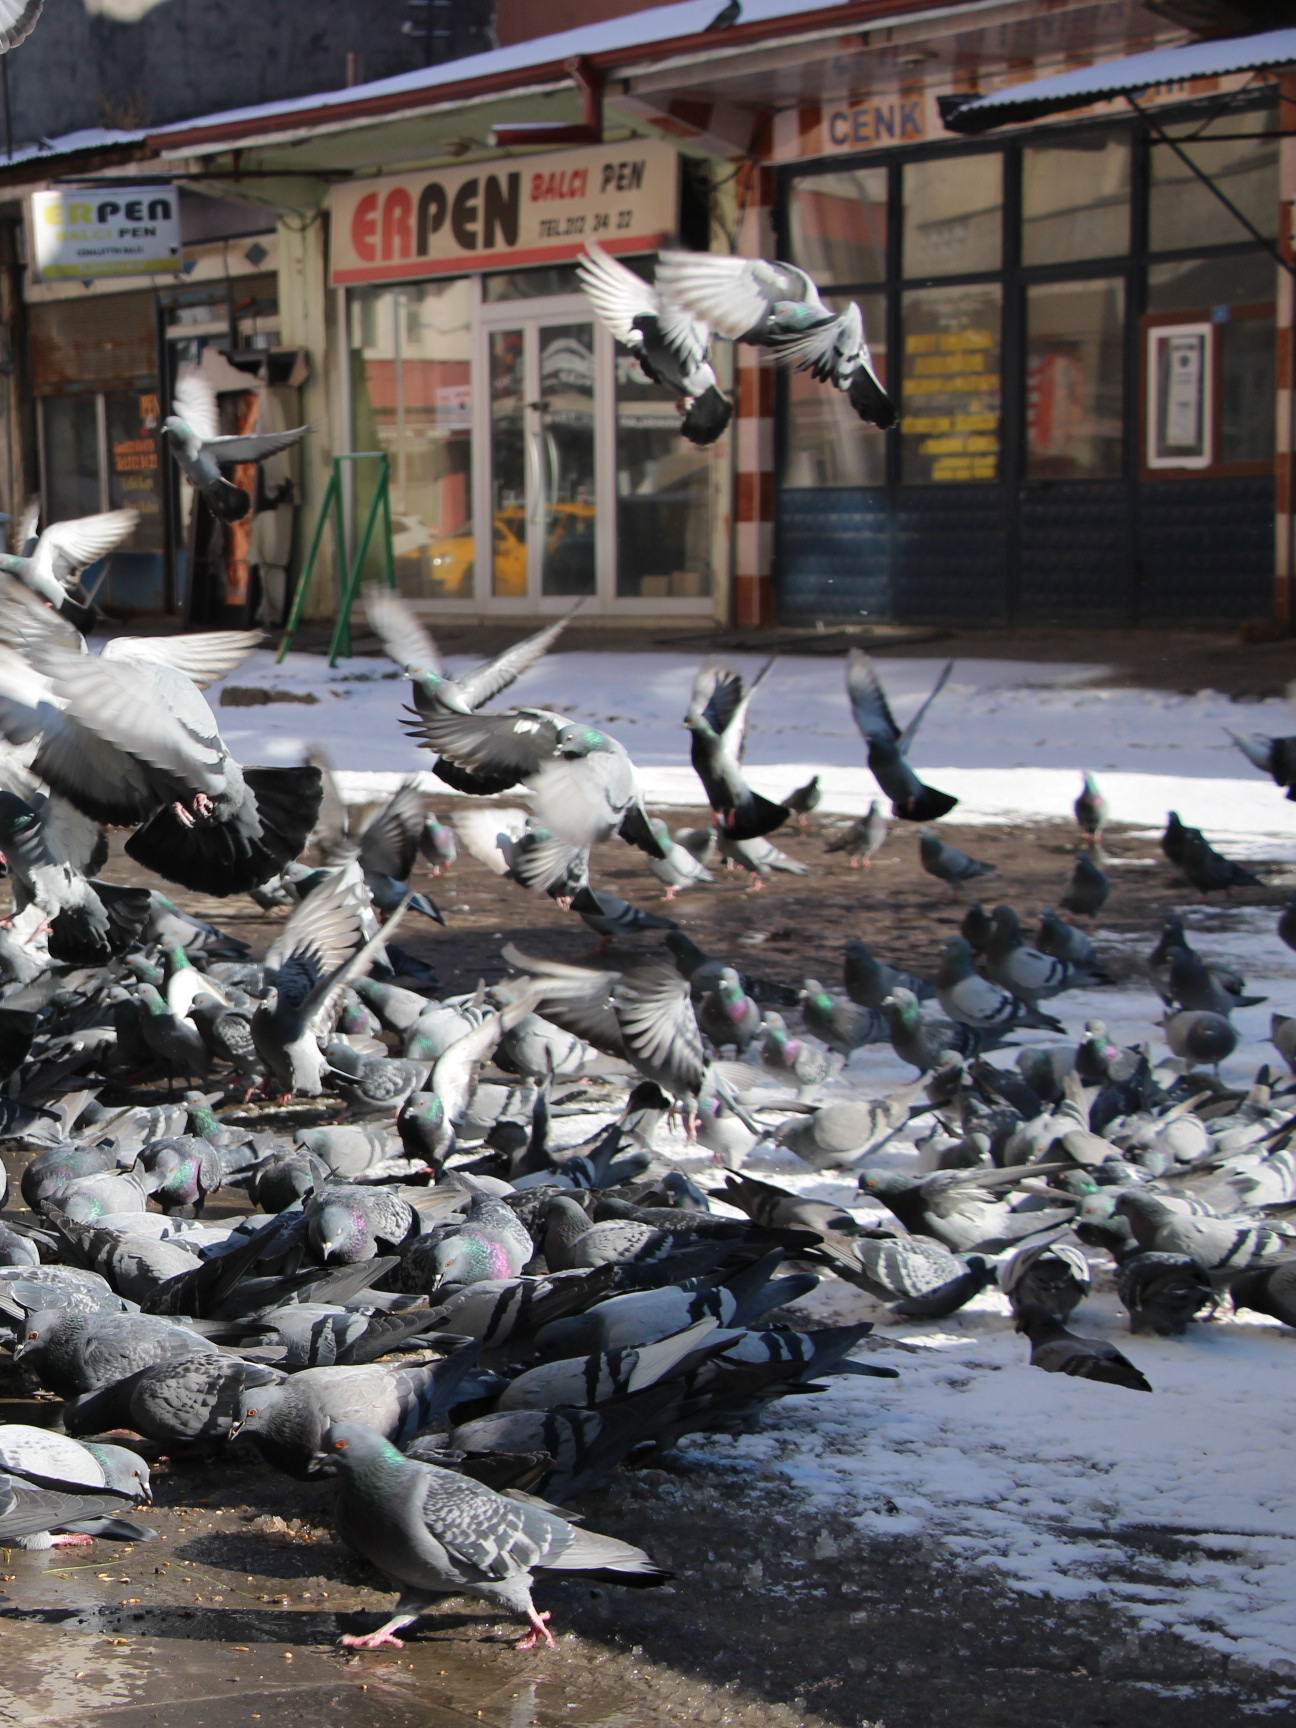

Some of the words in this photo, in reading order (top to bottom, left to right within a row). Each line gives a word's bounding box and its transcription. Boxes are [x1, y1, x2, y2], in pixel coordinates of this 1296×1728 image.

[828, 100, 922, 146] CENK
[599, 160, 646, 194] PEN
[44, 198, 172, 226] ERPEN
[350, 171, 521, 263] ERPEN
[119, 225, 157, 239] PEN
